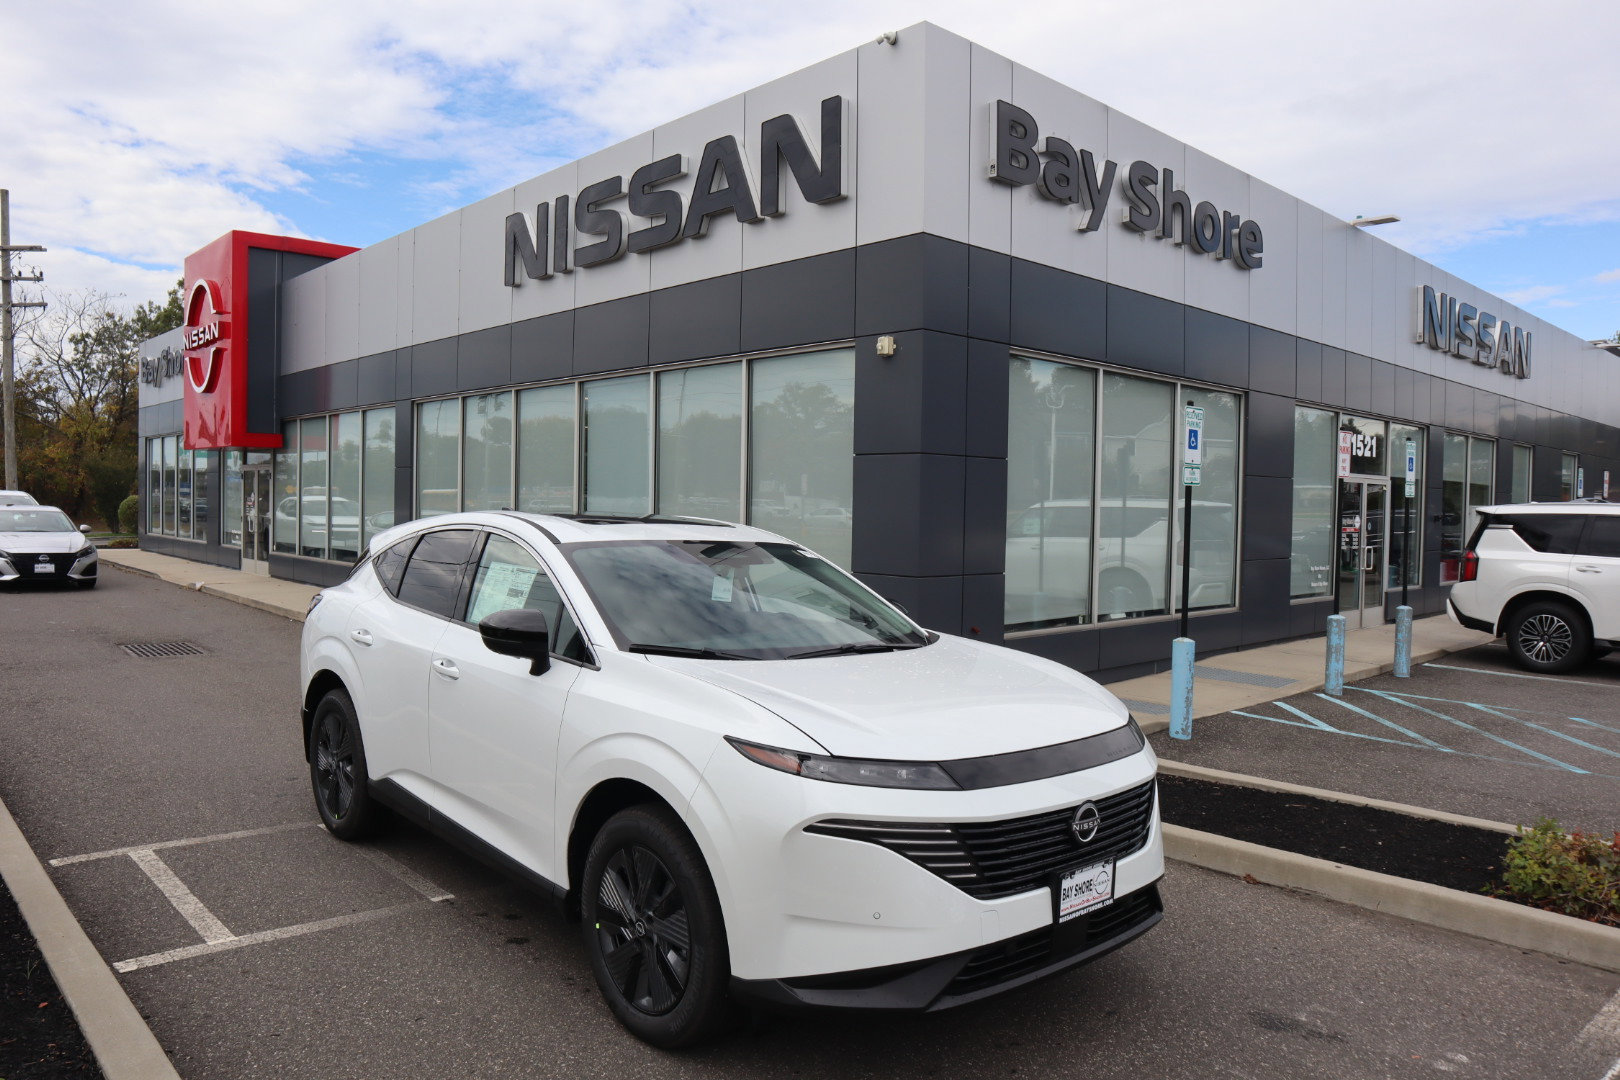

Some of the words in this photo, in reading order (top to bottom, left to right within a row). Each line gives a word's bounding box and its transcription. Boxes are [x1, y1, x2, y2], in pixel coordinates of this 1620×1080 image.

[504, 94, 845, 287] NISSAN
[990, 99, 1118, 232] Bay
[1122, 160, 1263, 270] Shore
[183, 321, 218, 350] NISSAN
[1419, 285, 1532, 379] NISSAN
[1351, 434, 1376, 457] 1521
[1072, 818, 1101, 832] NISSAN
[1062, 885, 1074, 901] BAY
[1074, 878, 1093, 897] SHORE
